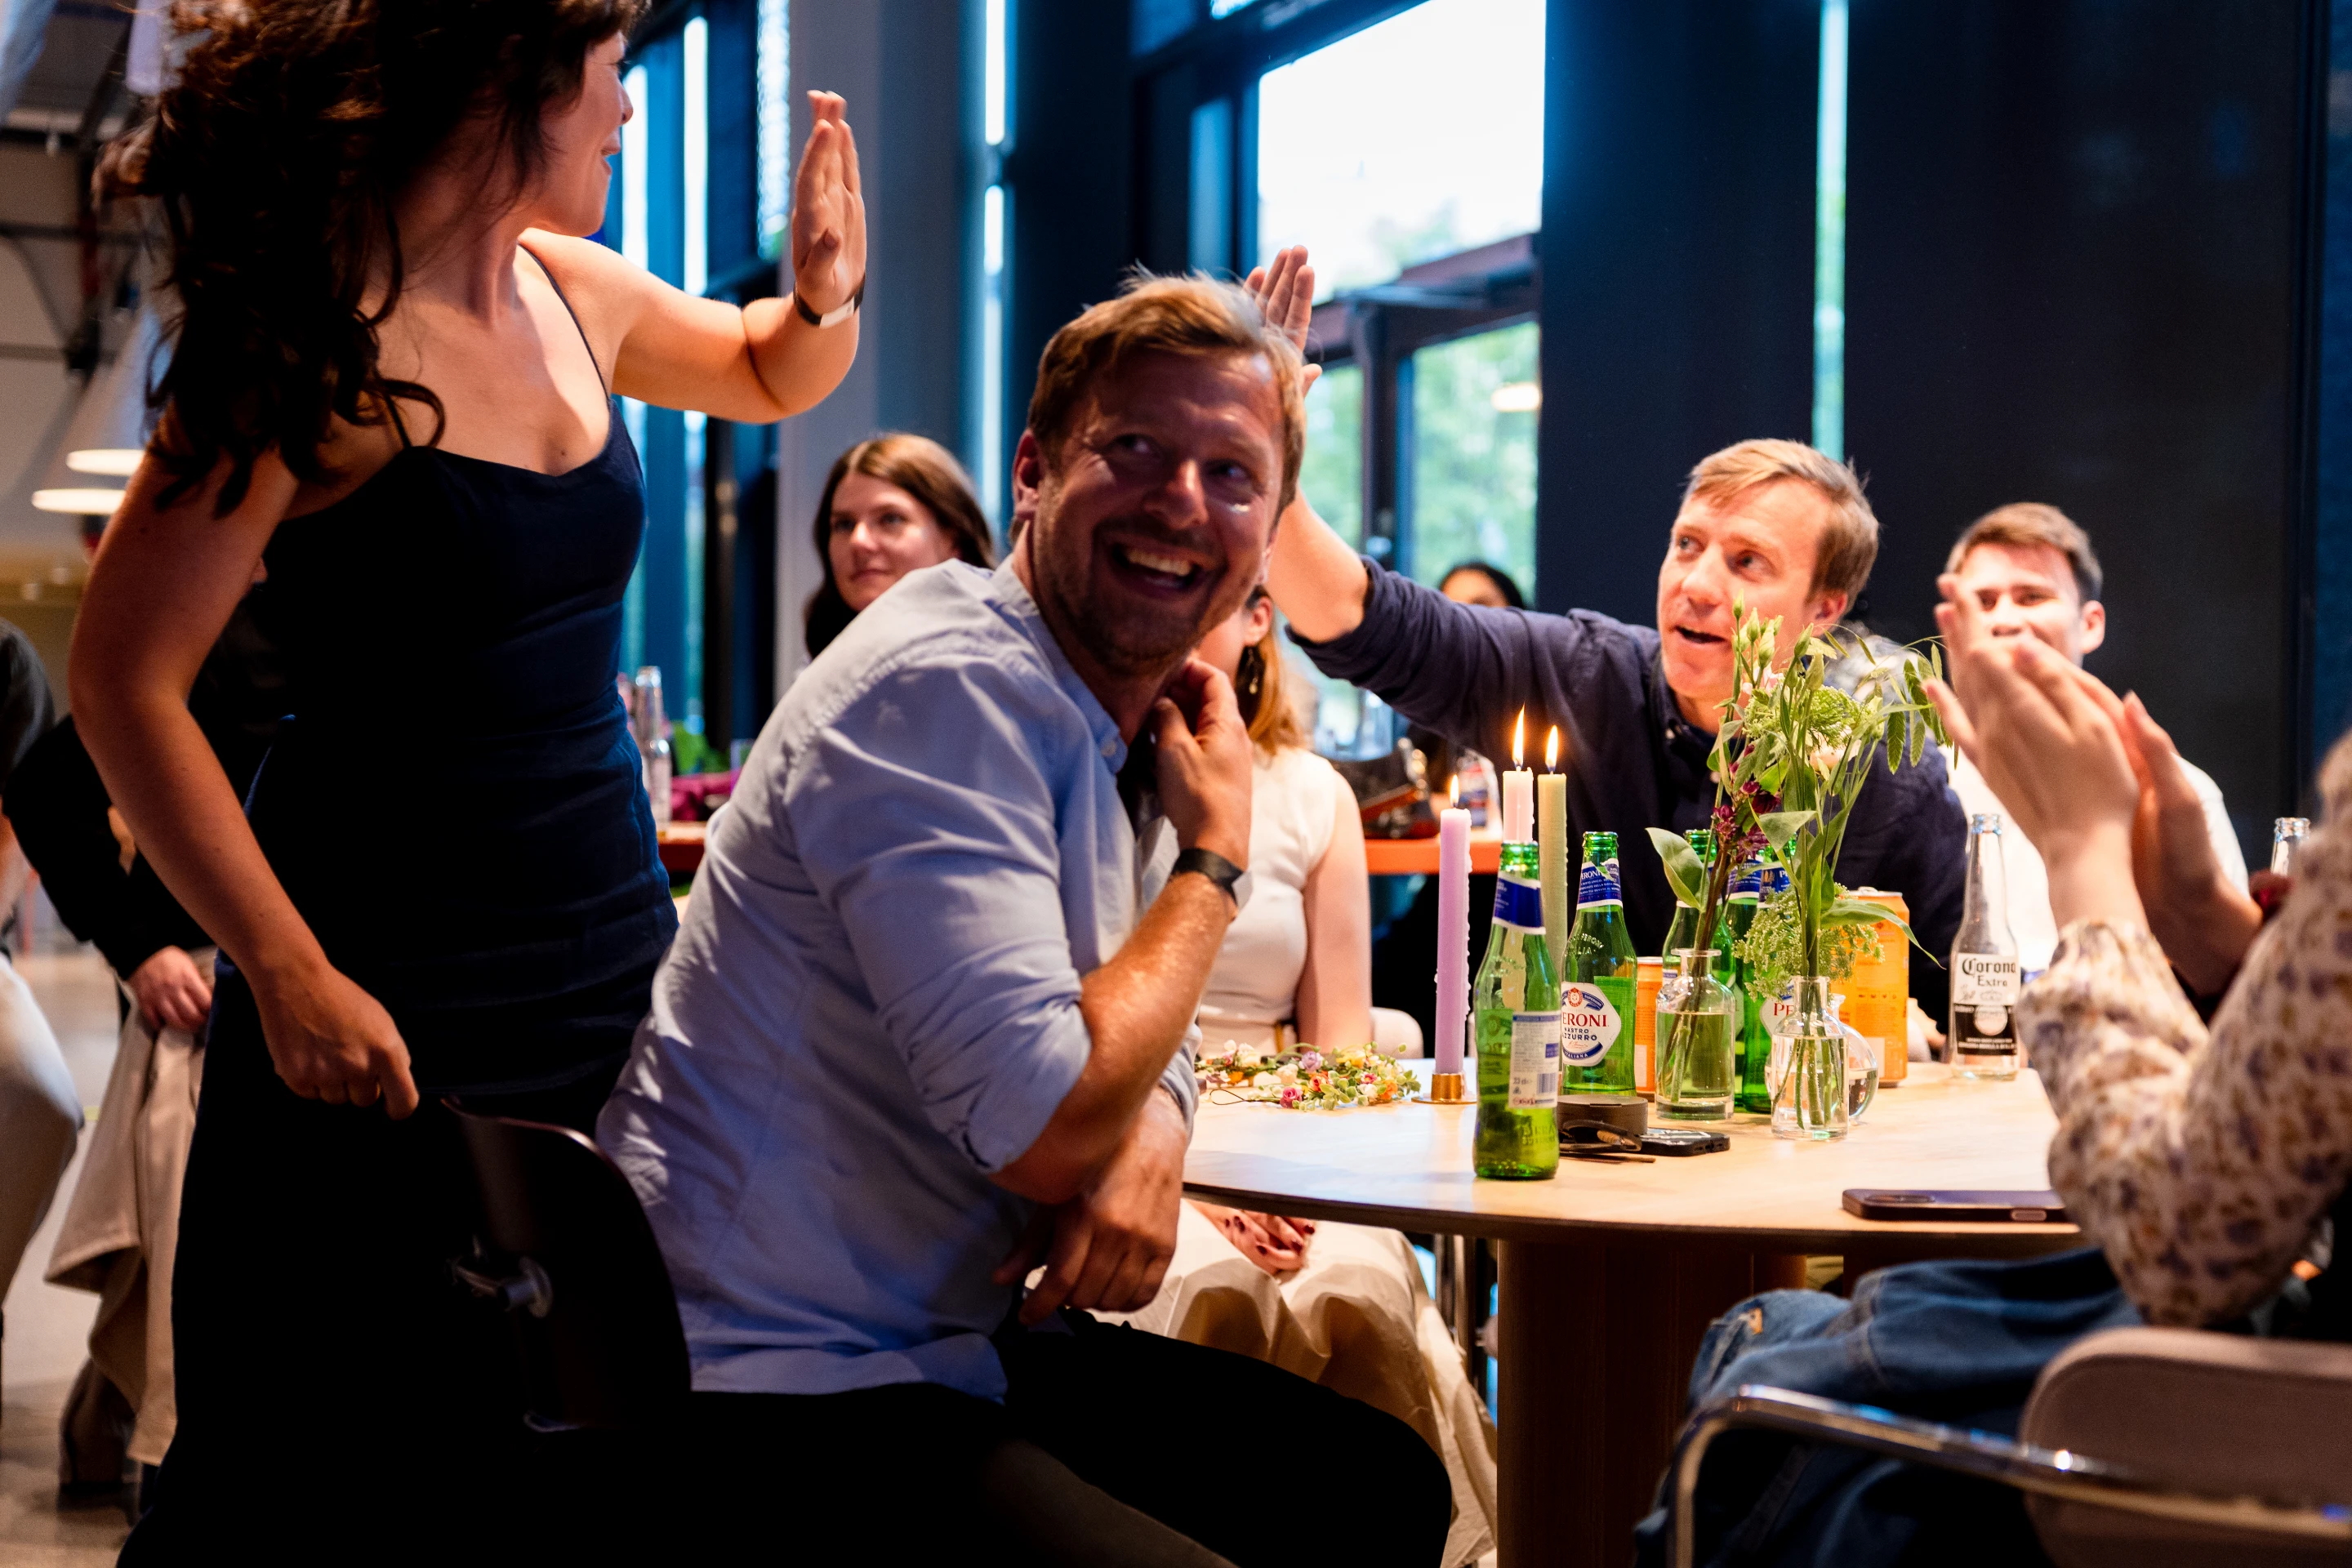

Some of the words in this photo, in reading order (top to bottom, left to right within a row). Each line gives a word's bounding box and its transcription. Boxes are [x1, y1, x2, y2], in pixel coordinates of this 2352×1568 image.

[1581, 870, 1601, 880] ERONI
[1962, 957, 2016, 978] Corona
[1977, 975, 2008, 987] Extra
[1561, 1012, 1607, 1027] ERONI
